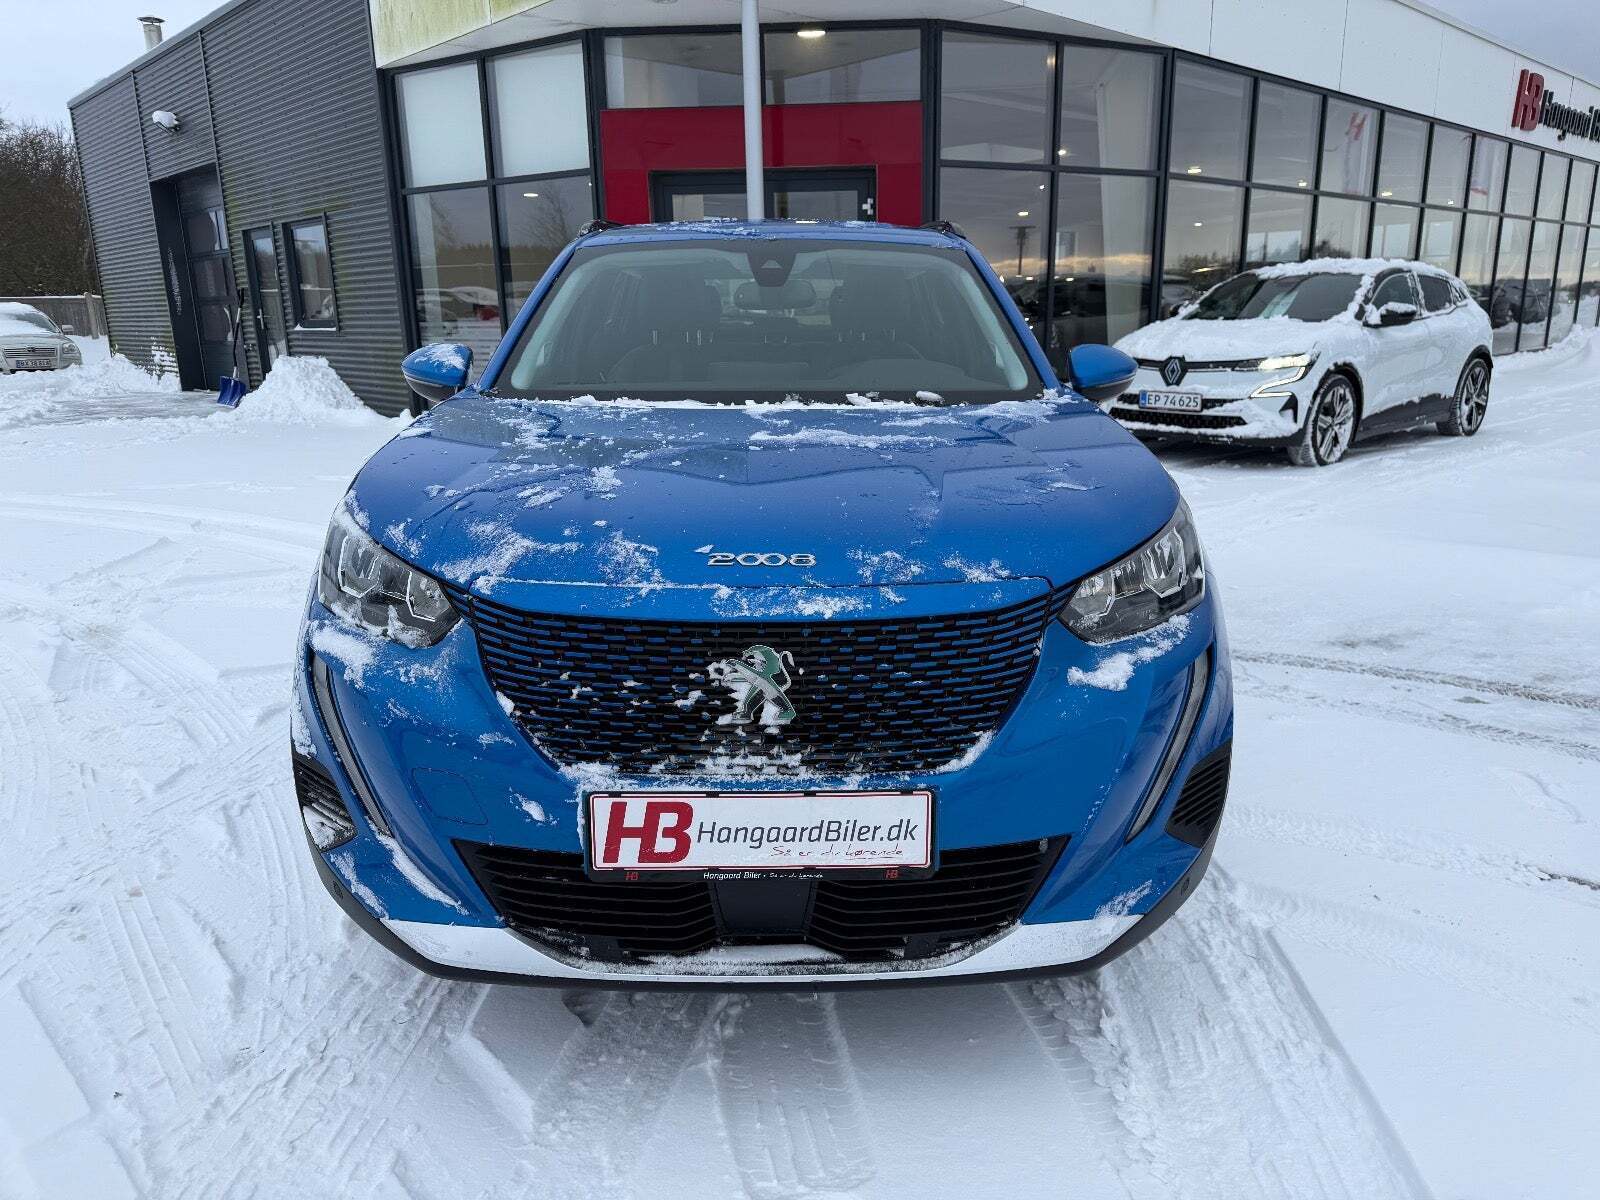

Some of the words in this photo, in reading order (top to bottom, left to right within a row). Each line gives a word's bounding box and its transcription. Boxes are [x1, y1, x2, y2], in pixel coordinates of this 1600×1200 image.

[1147, 394, 1161, 406] EP
[707, 552, 816, 566] 2008
[602, 801, 694, 864] HB
[696, 818, 919, 849] HangaardBiler.dk
